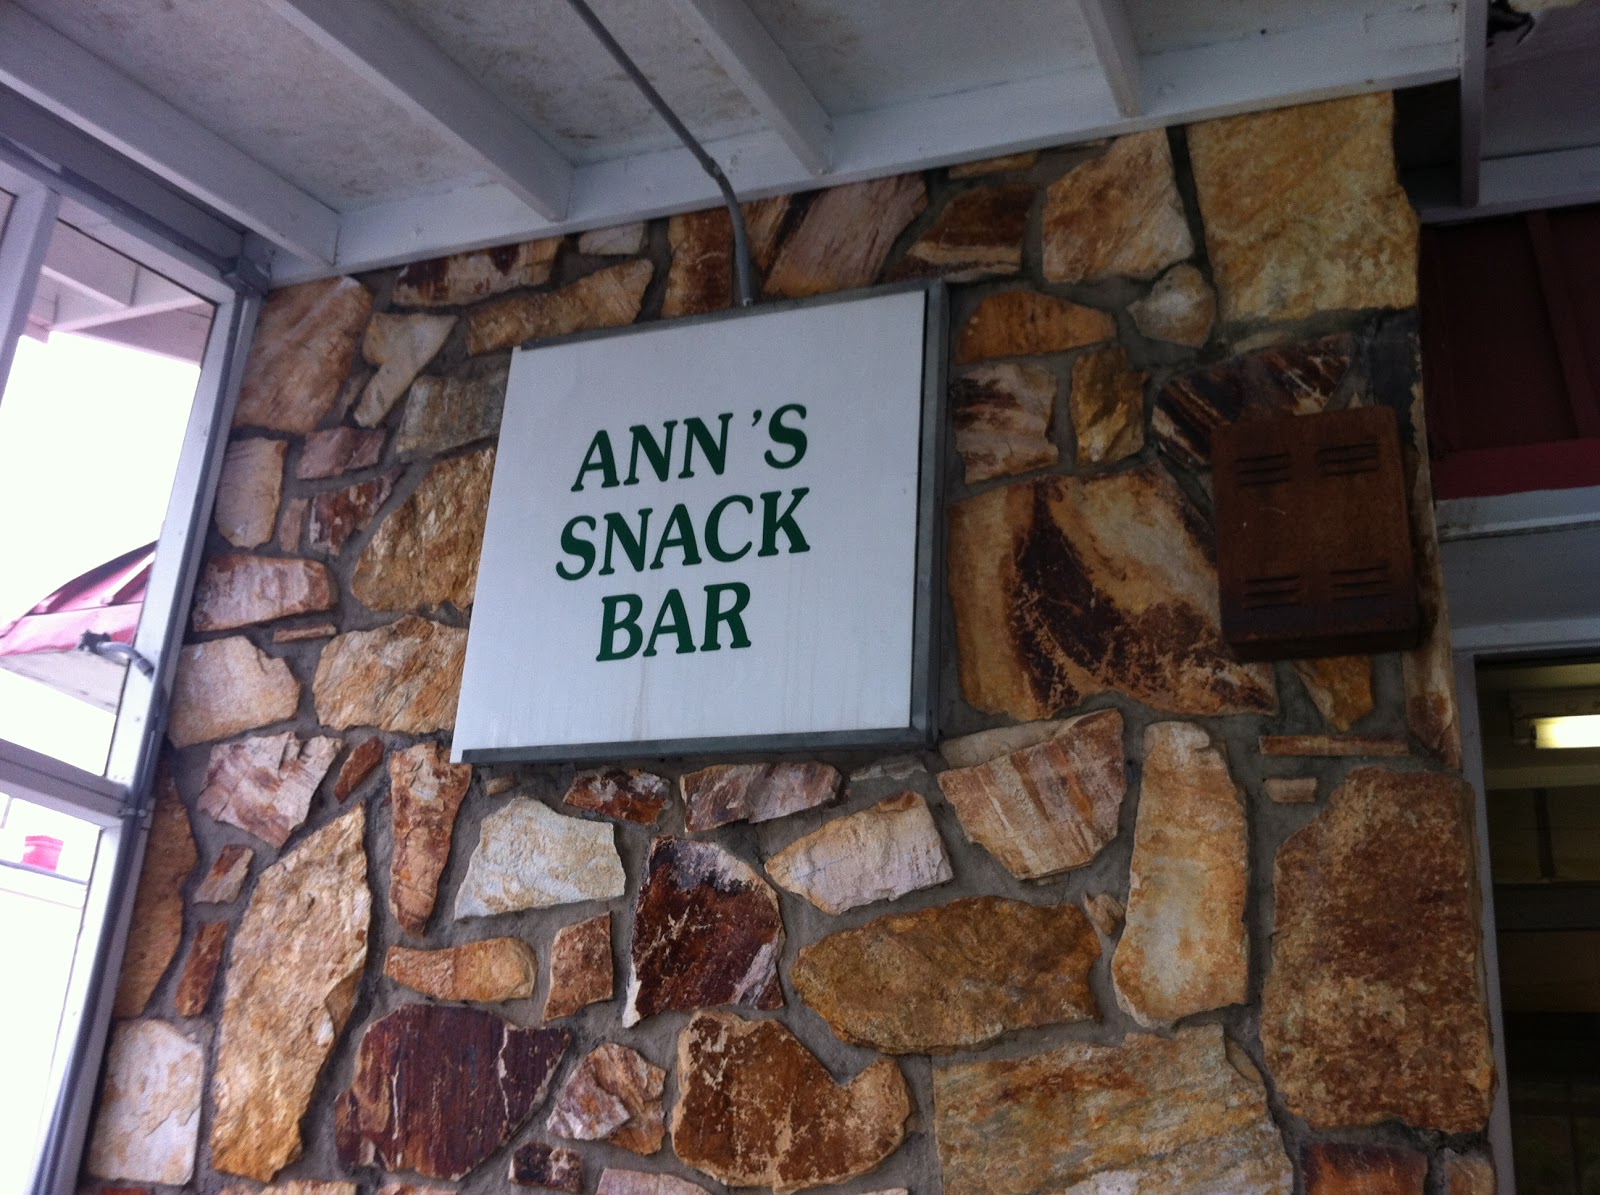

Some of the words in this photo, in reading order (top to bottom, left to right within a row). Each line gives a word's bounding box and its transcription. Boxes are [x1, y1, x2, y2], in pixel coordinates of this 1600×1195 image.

[570, 402, 809, 493] ANN'S
[556, 486, 811, 582] SNACK
[595, 582, 752, 663] BAR
